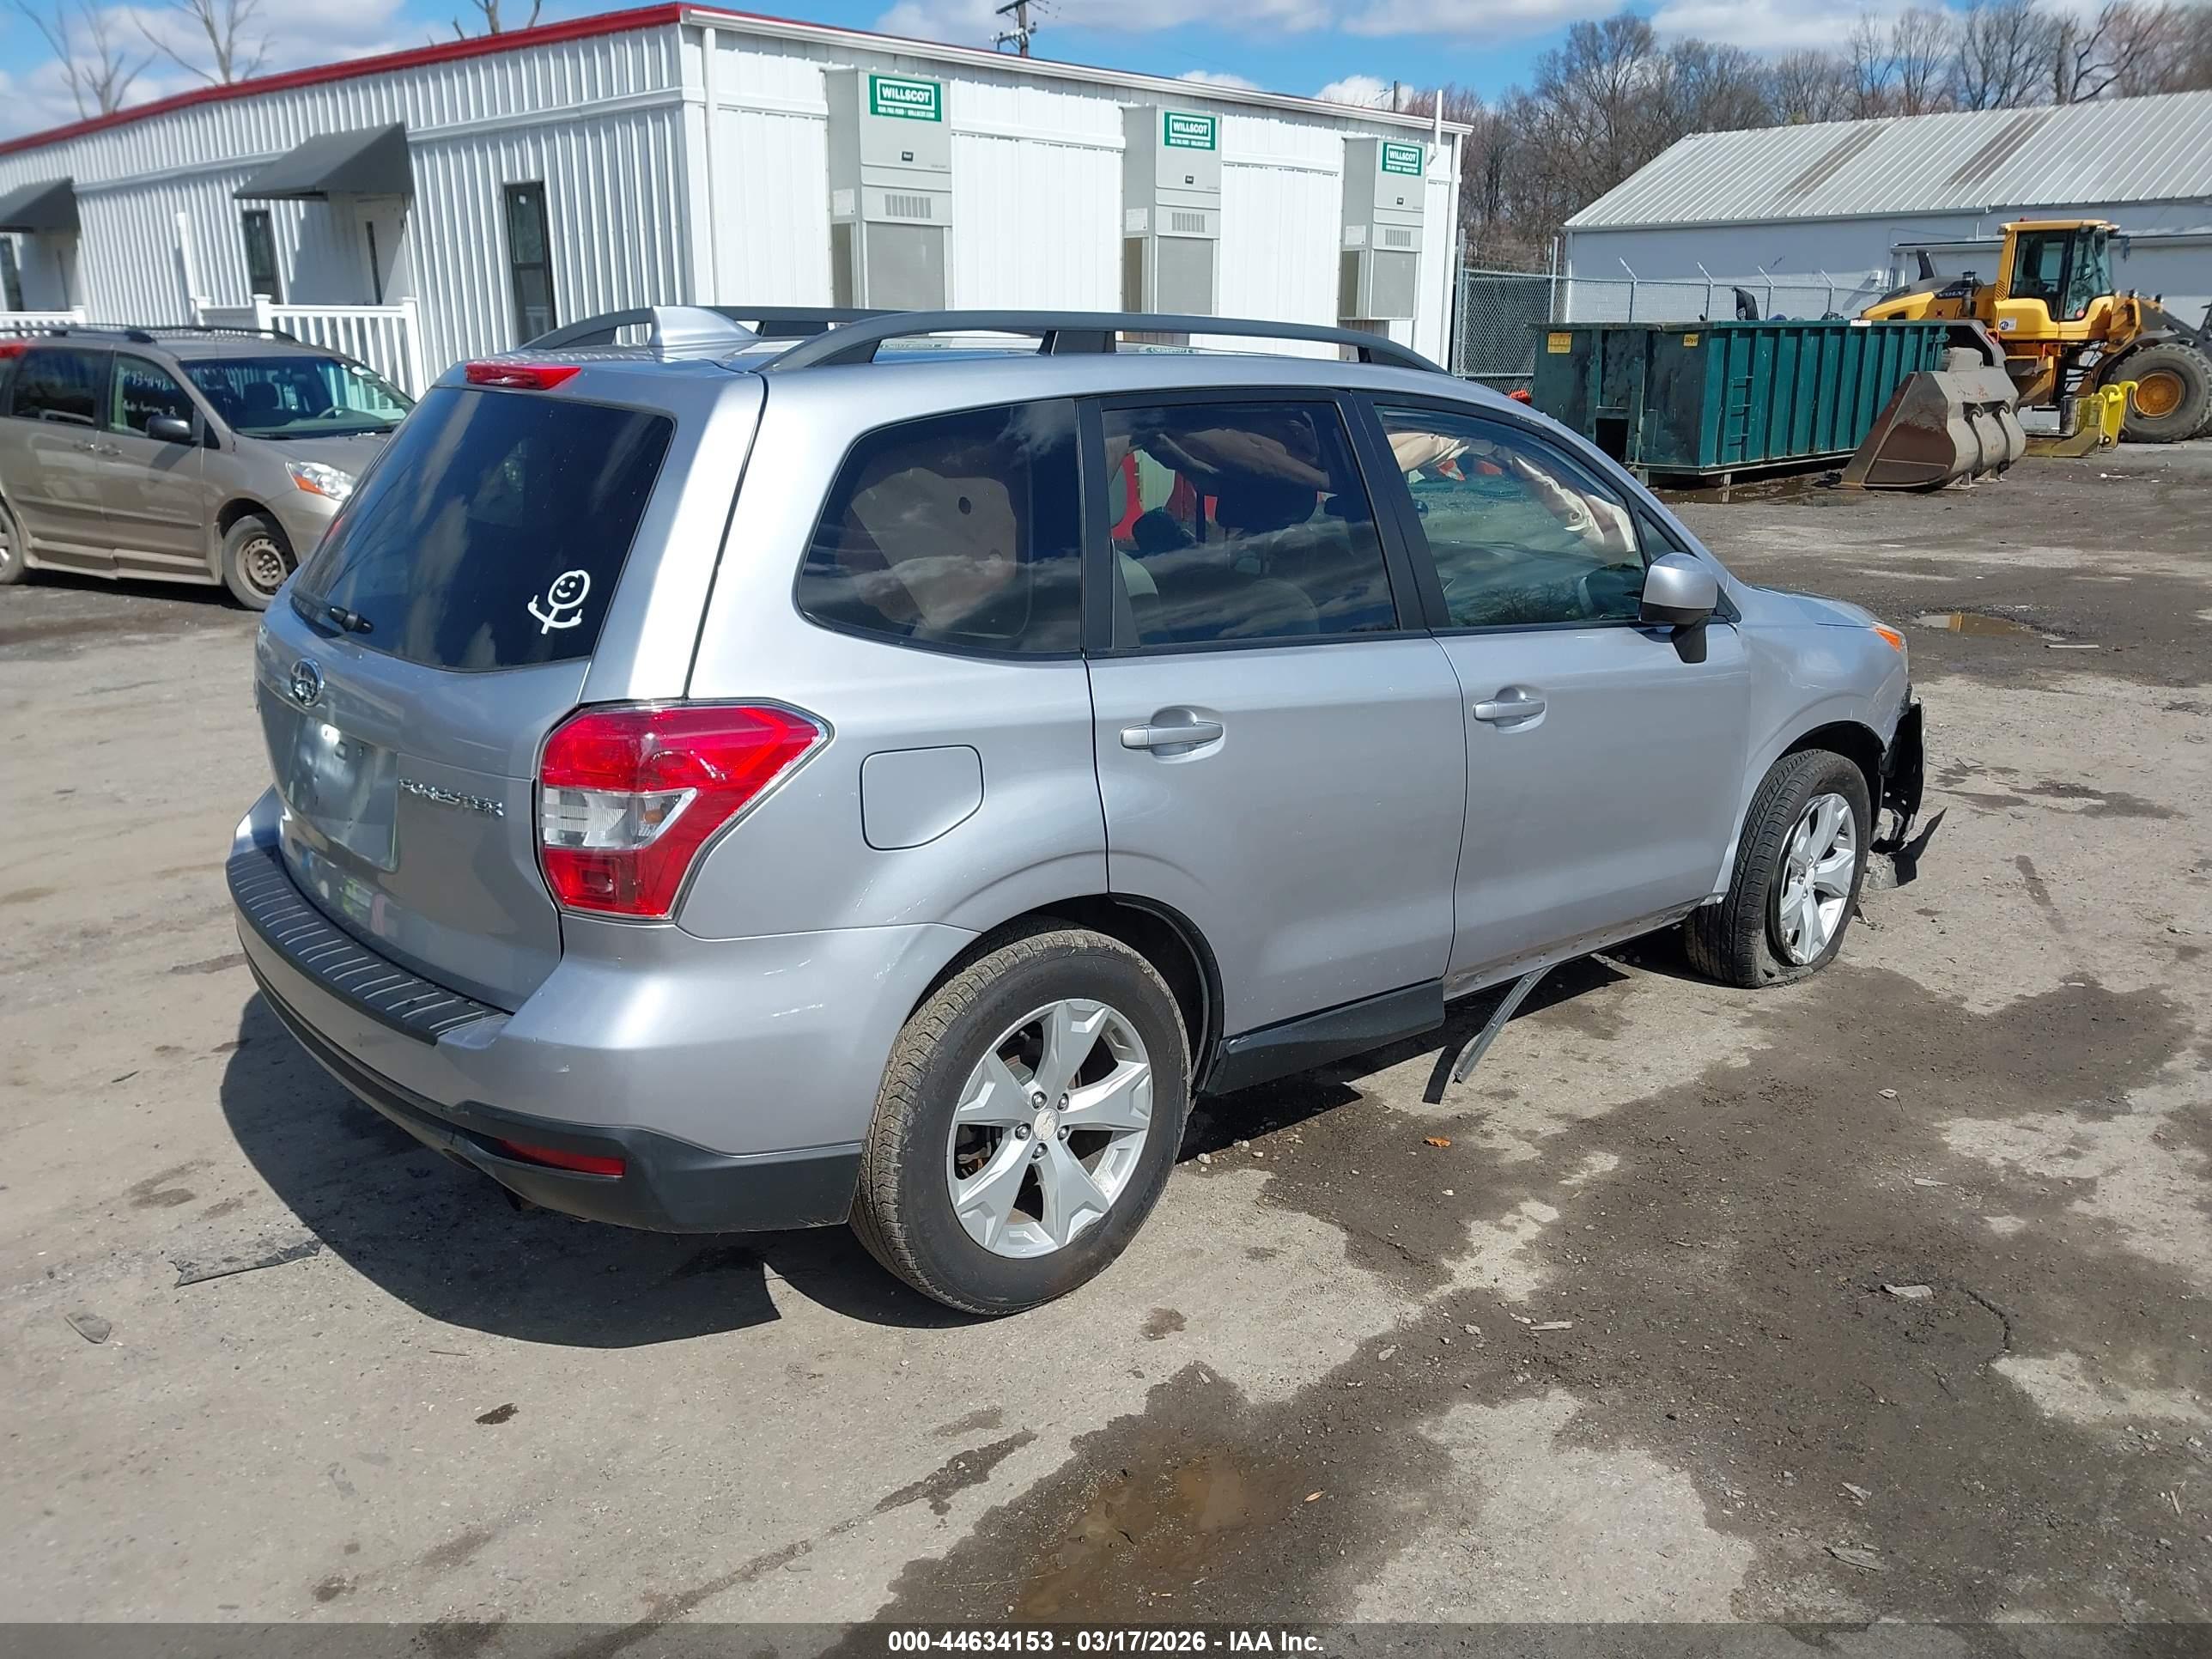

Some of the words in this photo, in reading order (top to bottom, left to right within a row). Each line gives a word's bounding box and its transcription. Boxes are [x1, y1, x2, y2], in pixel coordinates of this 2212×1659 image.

[882, 86, 930, 103] WILLSCOT
[1173, 121, 1208, 135] WILLSCOT
[1389, 150, 1416, 162] WILLSCOT
